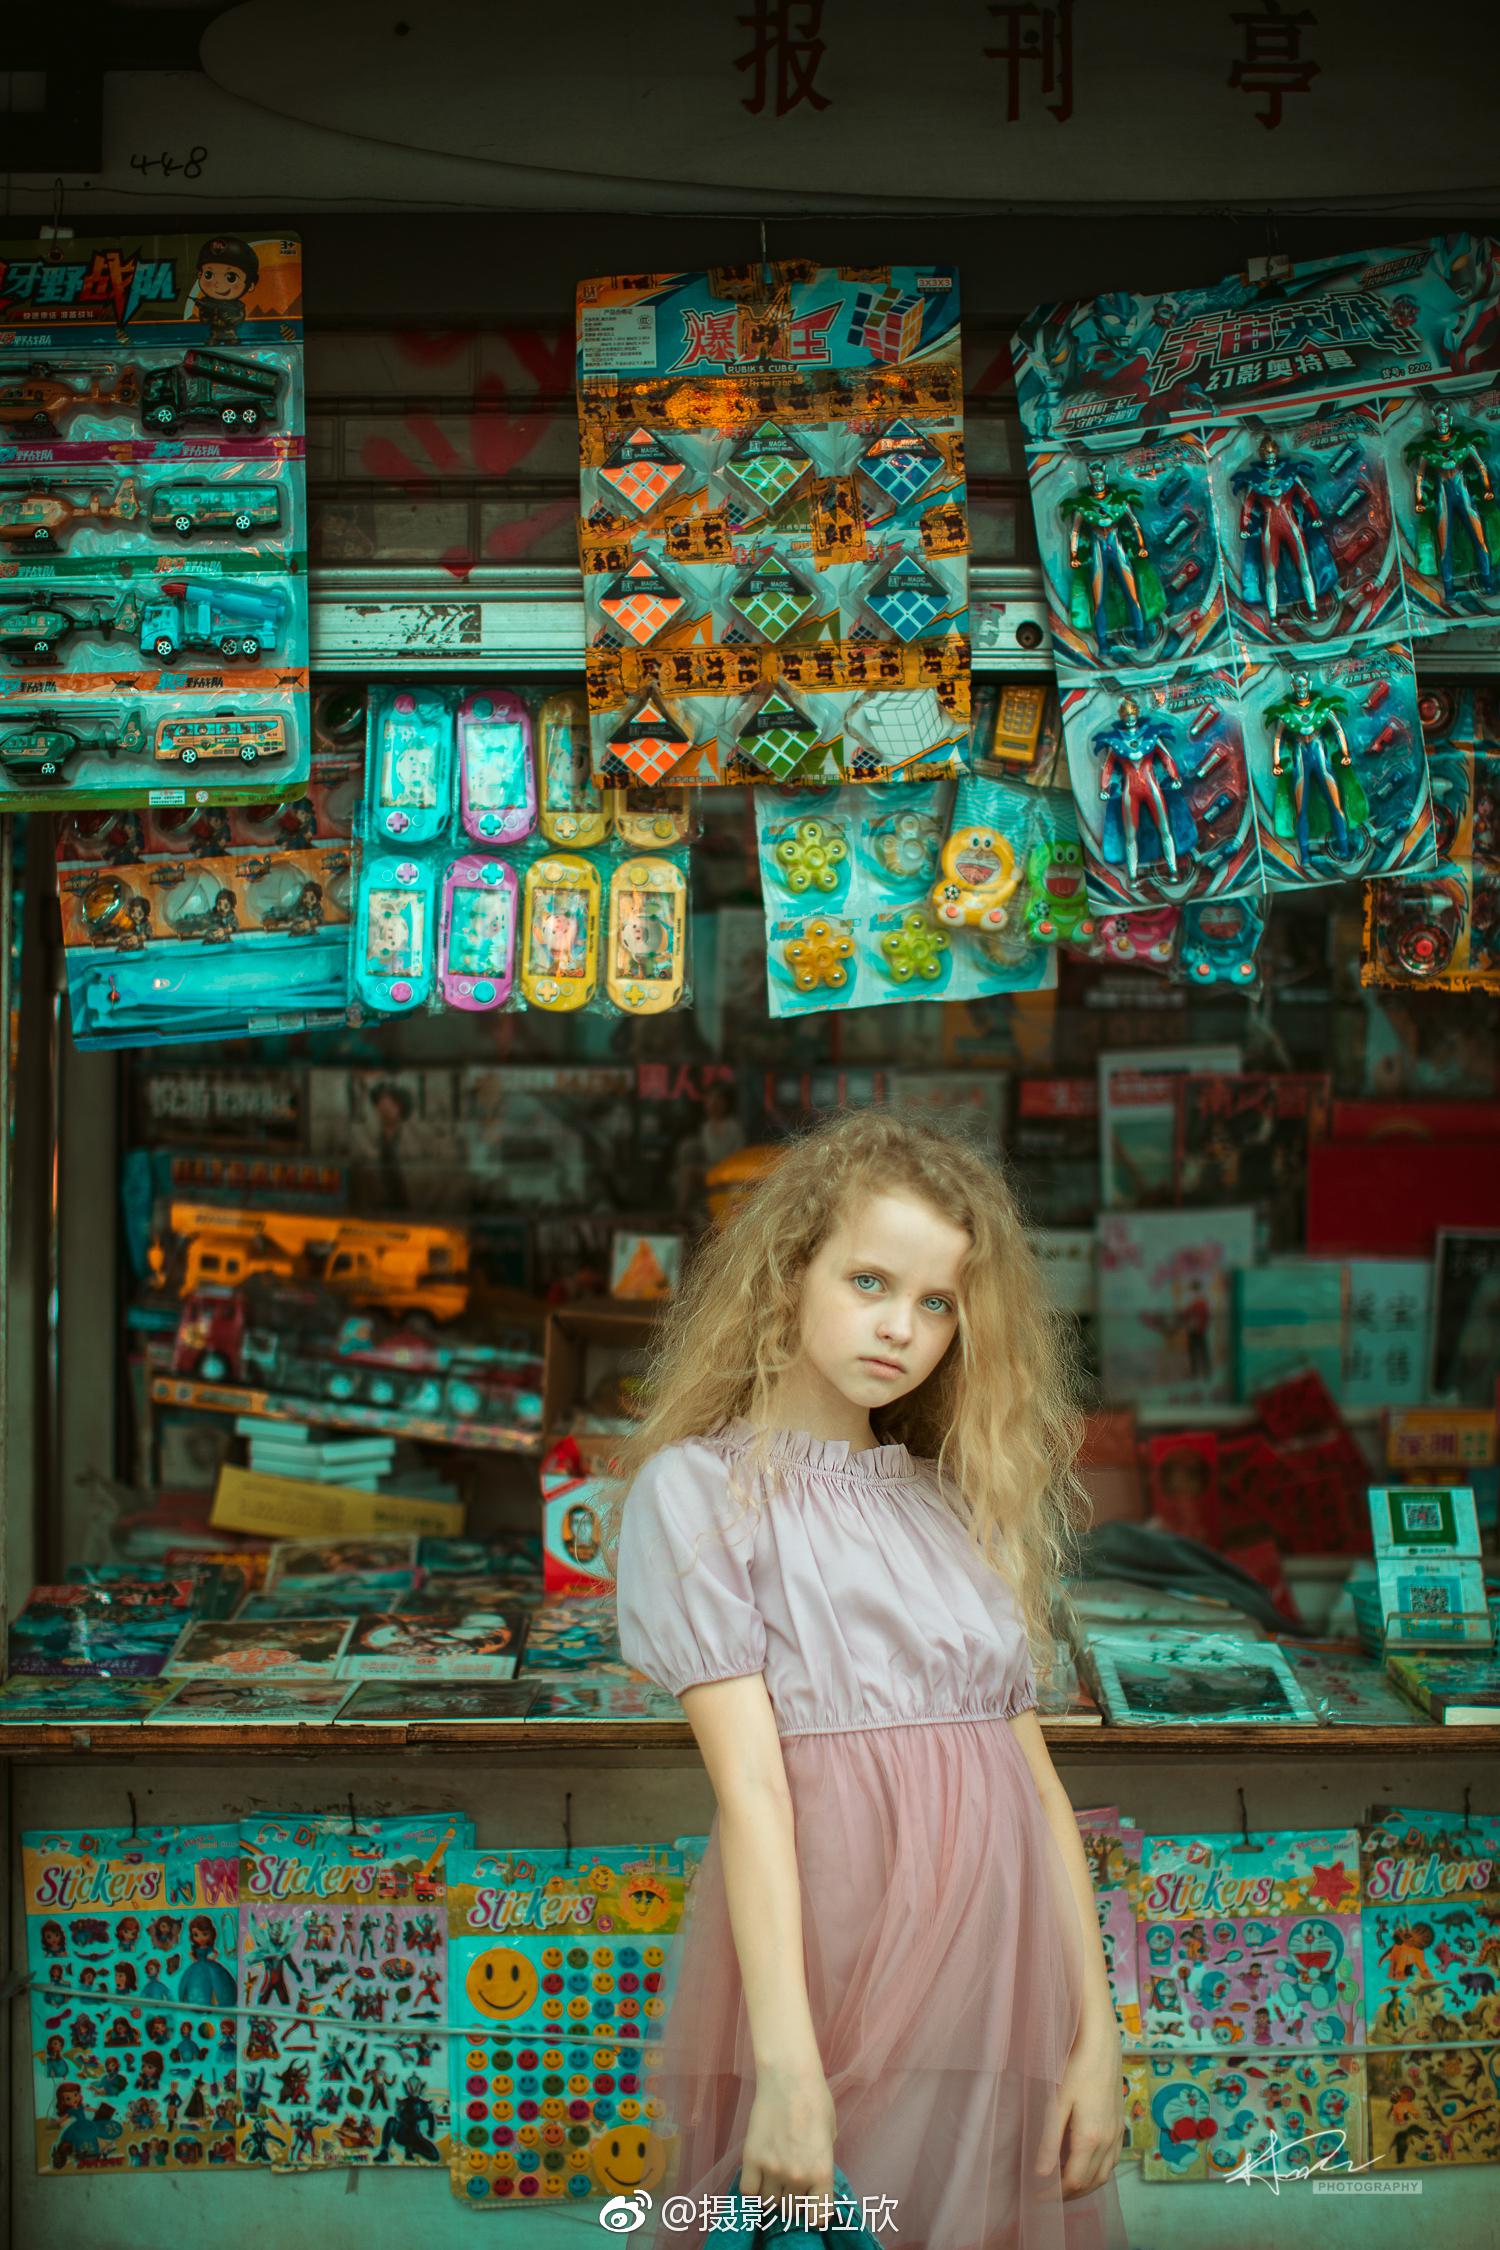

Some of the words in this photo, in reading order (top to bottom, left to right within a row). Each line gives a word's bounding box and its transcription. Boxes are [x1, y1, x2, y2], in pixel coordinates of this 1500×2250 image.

[734, 0, 1321, 129] 报刊亭
[130, 145, 209, 179] 448
[0, 247, 176, 326] 牙野战队
[668, 300, 845, 373] 爆王
[1149, 291, 1421, 396] 宇宙英雄
[768, 364, 795, 373] CUBE
[1204, 349, 1357, 392] 幻影奥特曼
[1408, 362, 1433, 374] 2202
[0, 445, 53, 462] 牙野战队
[640, 446, 660, 454] MAGIC
[0, 561, 56, 577] 牙野战队
[0, 677, 57, 694] 牙野战队
[171, 1157, 341, 1195] ULTRAMAN
[79, 1834, 110, 1855] DIY
[35, 1859, 160, 1906] Stickers
[248, 1855, 376, 1898] Stickers
[1148, 1869, 1273, 1915] Stickers
[1370, 1854, 1491, 1901] Stickers
[467, 1885, 597, 1932] Stickers
